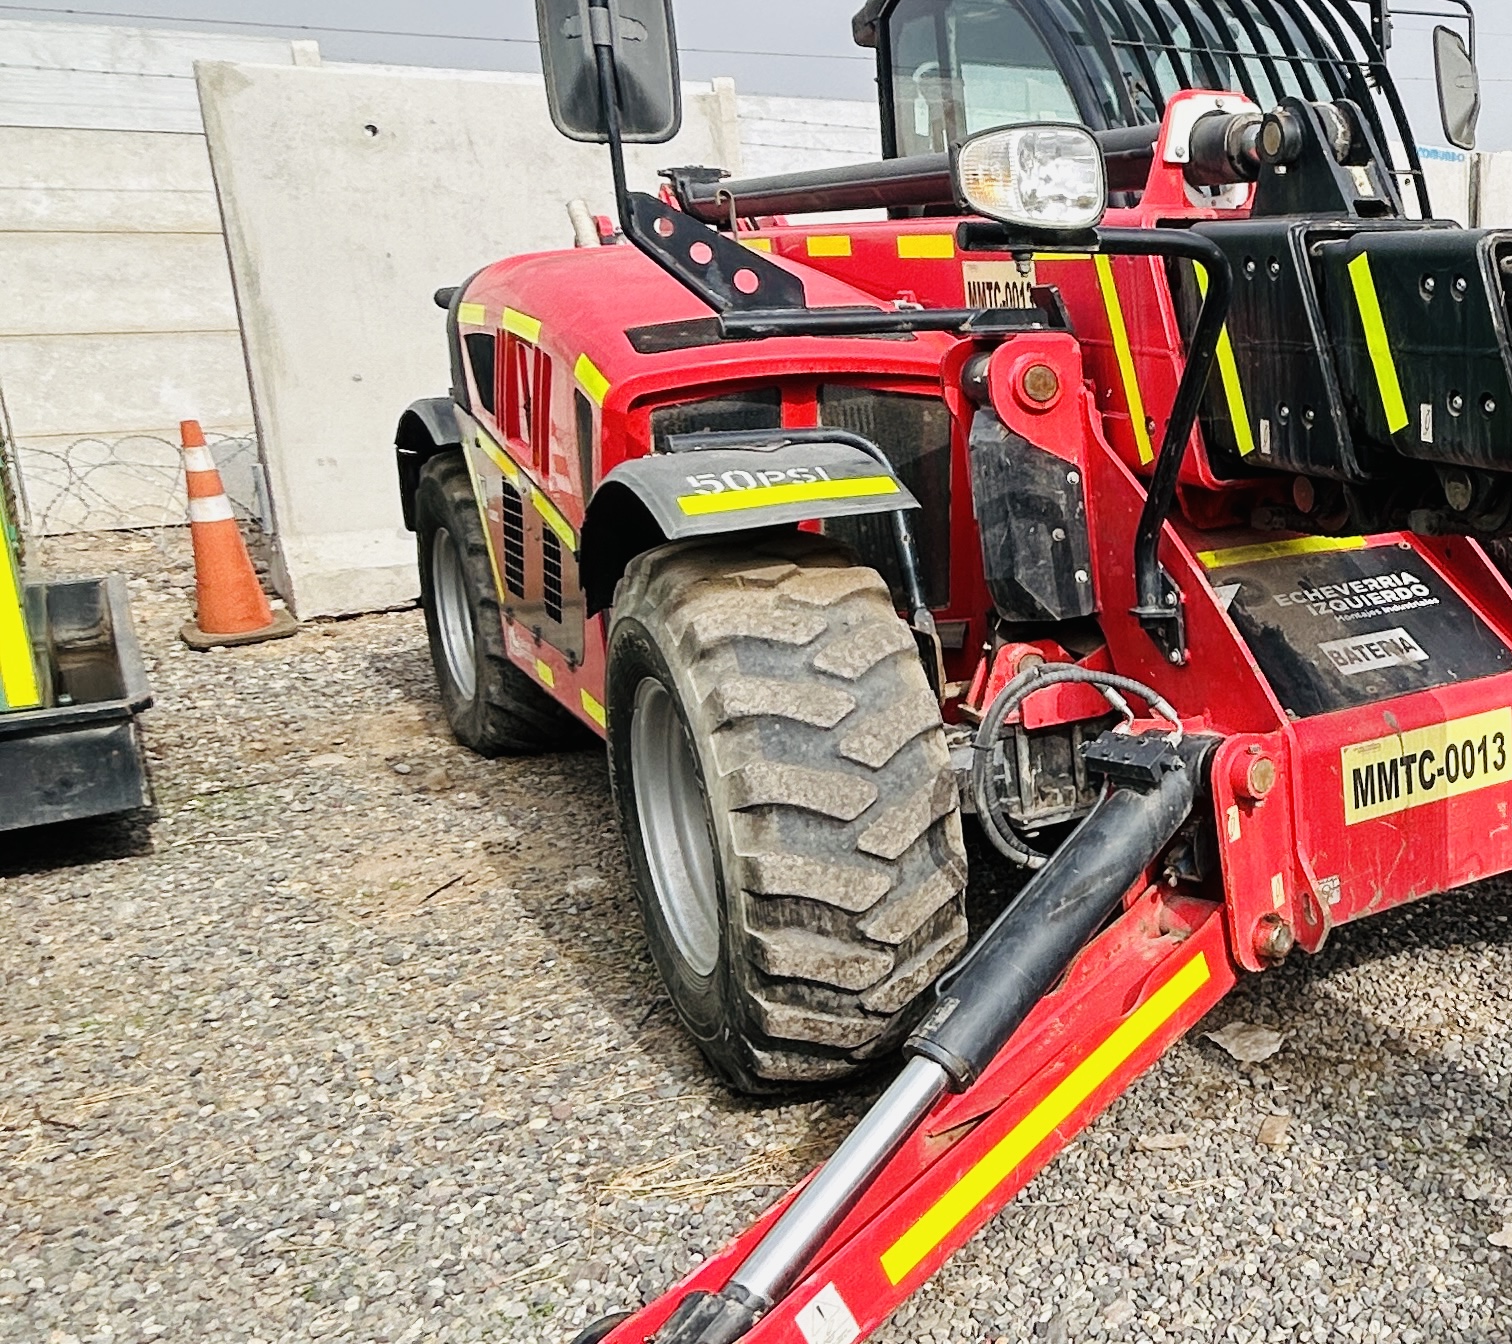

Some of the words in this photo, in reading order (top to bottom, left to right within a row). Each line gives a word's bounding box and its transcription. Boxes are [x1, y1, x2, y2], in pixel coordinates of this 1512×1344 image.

[1272, 571, 1420, 607] ECHEVERRIA
[1306, 583, 1430, 616] IZQUIERDO
[1381, 596, 1440, 613] Industriales
[1352, 731, 1506, 810] MMTC-0013
